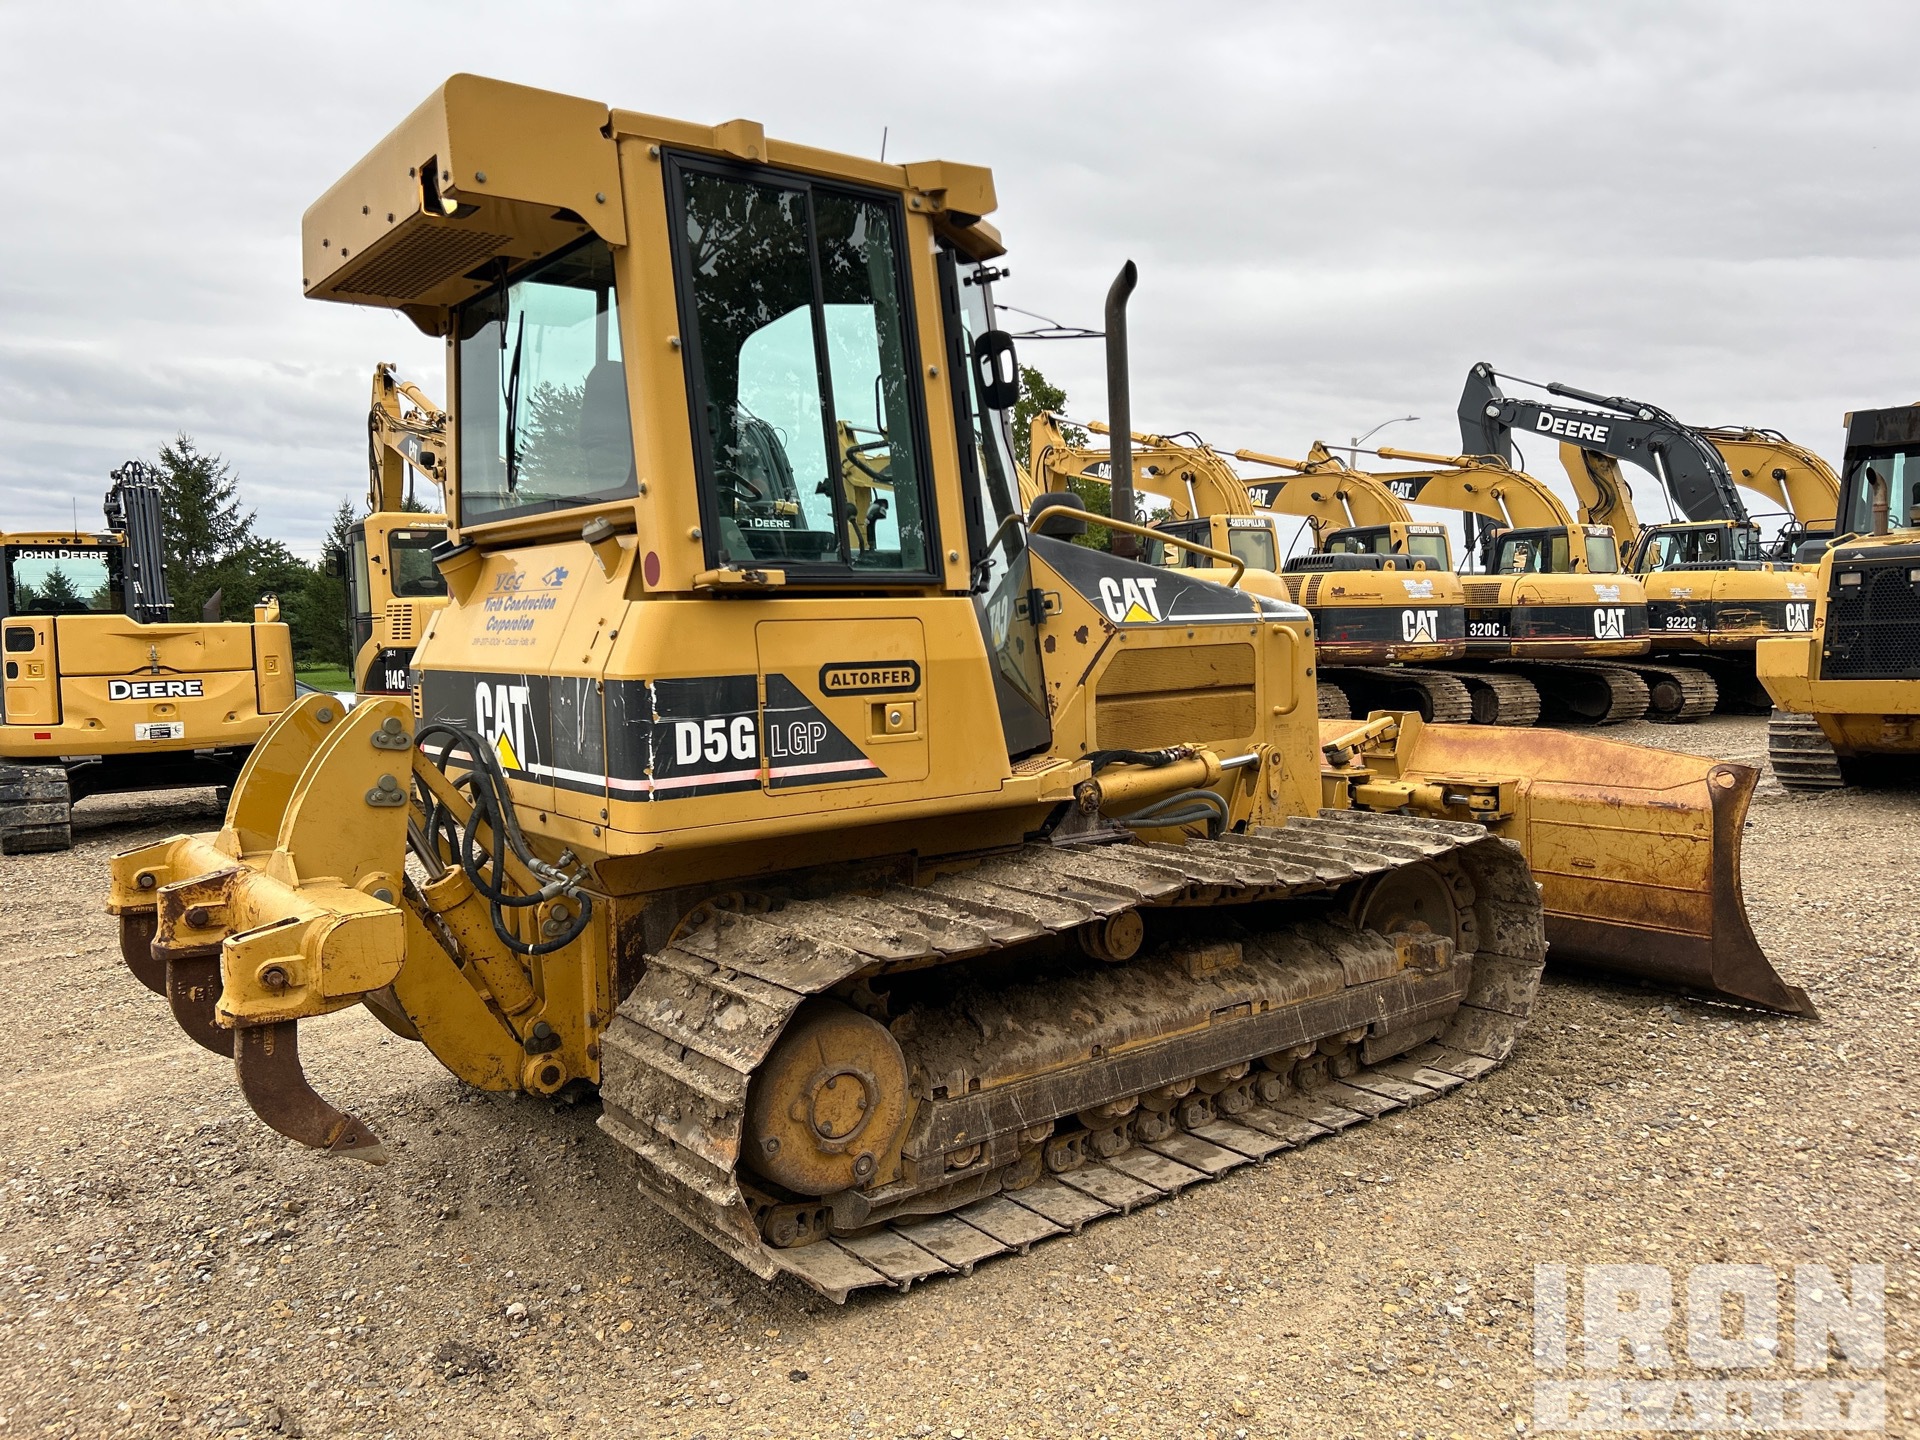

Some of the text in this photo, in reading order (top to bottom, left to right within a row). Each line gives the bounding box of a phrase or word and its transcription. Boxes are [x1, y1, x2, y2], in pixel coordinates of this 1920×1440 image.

[1536, 411, 1609, 443] DEERE
[1249, 487, 1269, 507] CAT
[1390, 481, 1413, 500] CAT
[754, 518, 790, 528] DEERE
[1230, 518, 1266, 528] CATERPILLAR
[1408, 525, 1440, 535] CATERPILLAR
[15, 549, 109, 560] JOHN DEERE
[504, 593, 557, 611] Construction
[1098, 577, 1162, 623] CAT
[486, 614, 535, 635] Corporation
[1402, 609, 1438, 642] CAT
[1593, 608, 1626, 639] CAT
[1666, 616, 1697, 629] 322C
[1785, 603, 1810, 632] CAT
[38, 632, 45, 645] 1
[1469, 622, 1500, 637] 320C
[385, 669, 405, 690] 314C
[830, 670, 911, 687] ALTORFER
[109, 680, 203, 700] DEERE
[475, 681, 528, 775] CAT
[675, 716, 827, 766] D5G LGP
